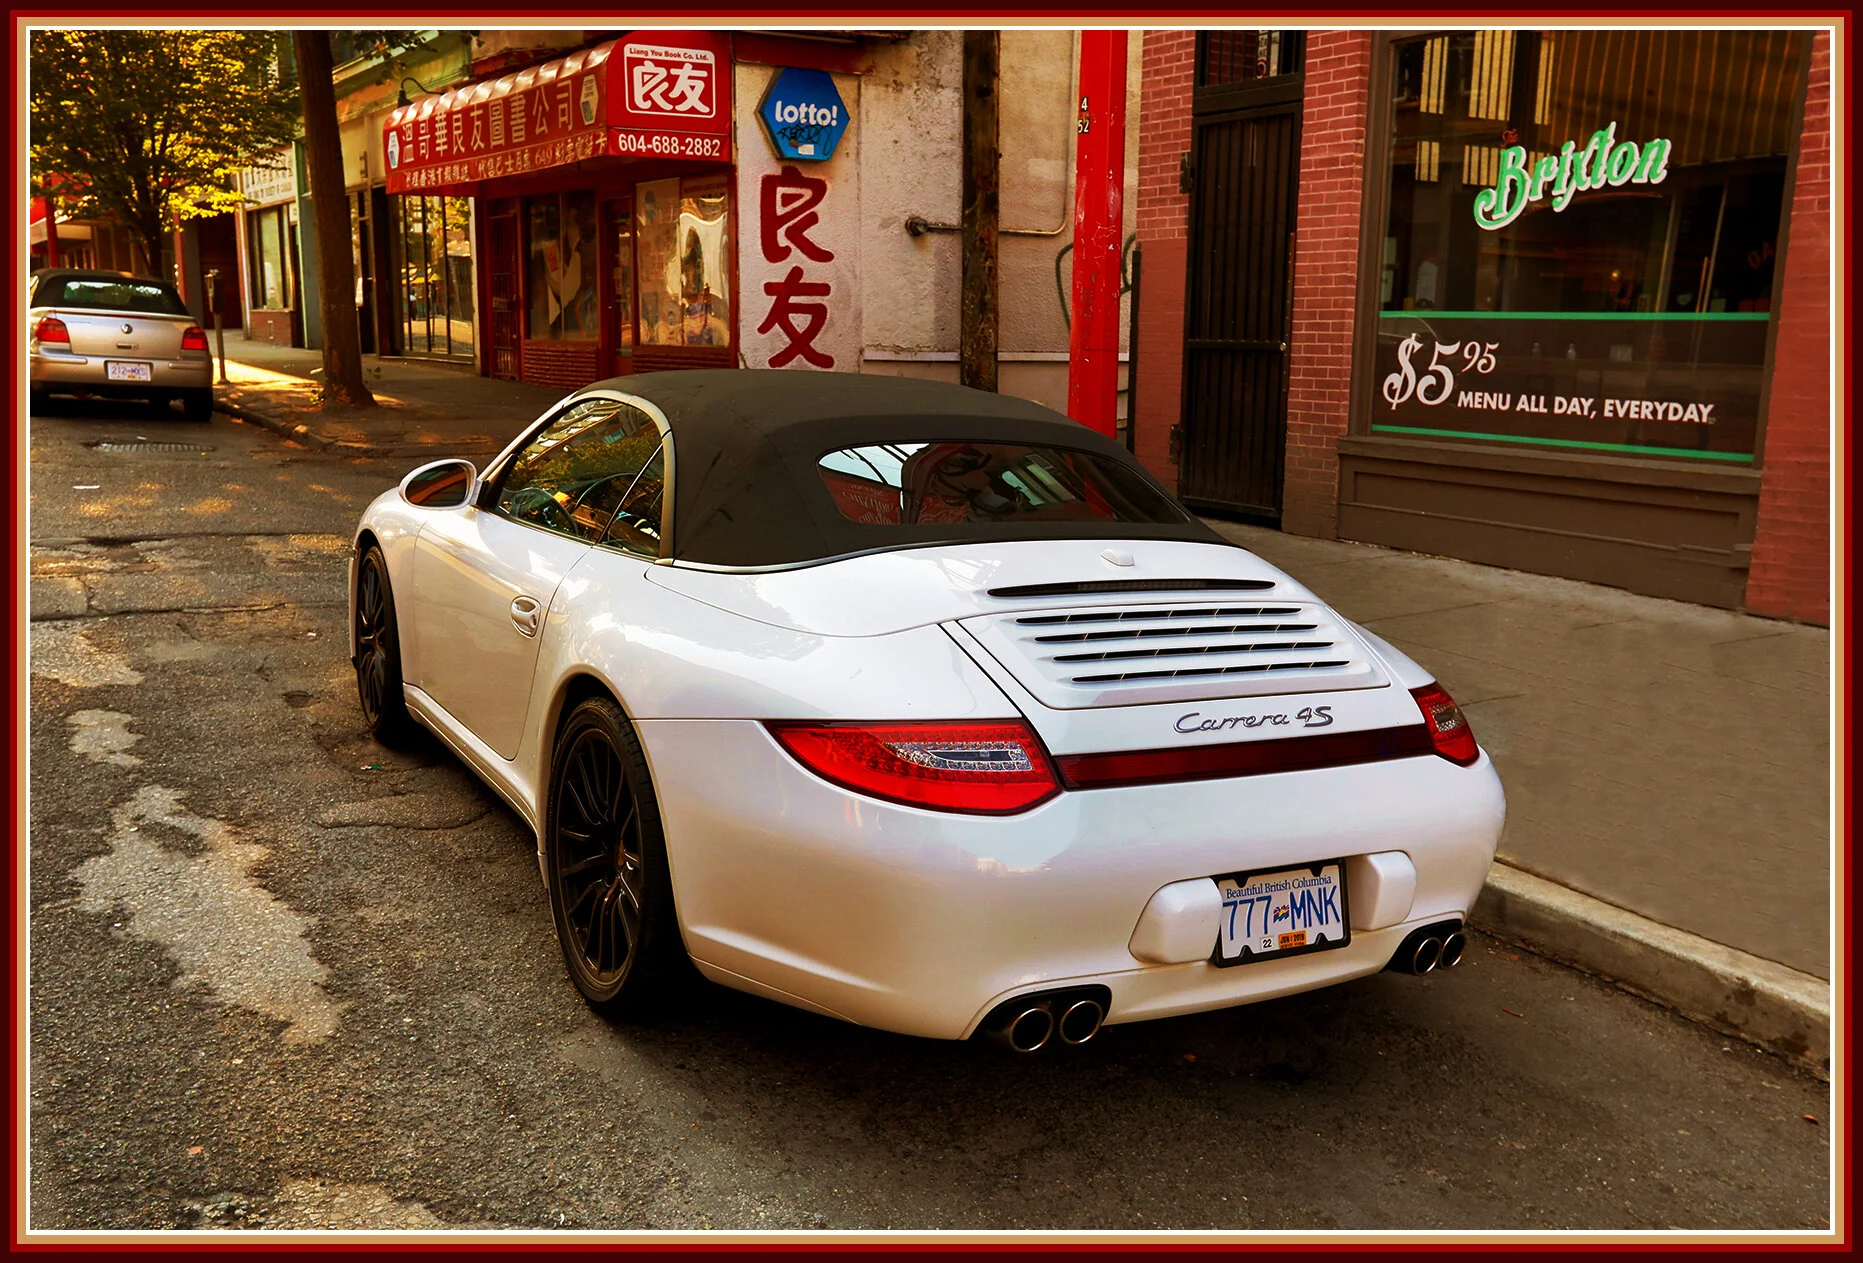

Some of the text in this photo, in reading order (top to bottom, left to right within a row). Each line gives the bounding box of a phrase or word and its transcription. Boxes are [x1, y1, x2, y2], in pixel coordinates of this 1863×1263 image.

[629, 47, 709, 61] Liang You Book Co. Ltd.
[633, 60, 711, 113] 良友
[775, 100, 838, 127] lotto!
[1081, 97, 1088, 110] 4
[1078, 119, 1089, 133] 52
[618, 133, 721, 156] 604-688-2882
[1473, 121, 1672, 231] Brixton
[757, 165, 835, 368] 良友
[1457, 391, 1714, 424] MENU ALL DAY, EVERYDAY
[1174, 706, 1334, 734] Carrera 4S
[1226, 875, 1332, 899] Beautiful British Columbia
[1222, 885, 1340, 940] 777 MNK
[1262, 938, 1272, 949] 22
